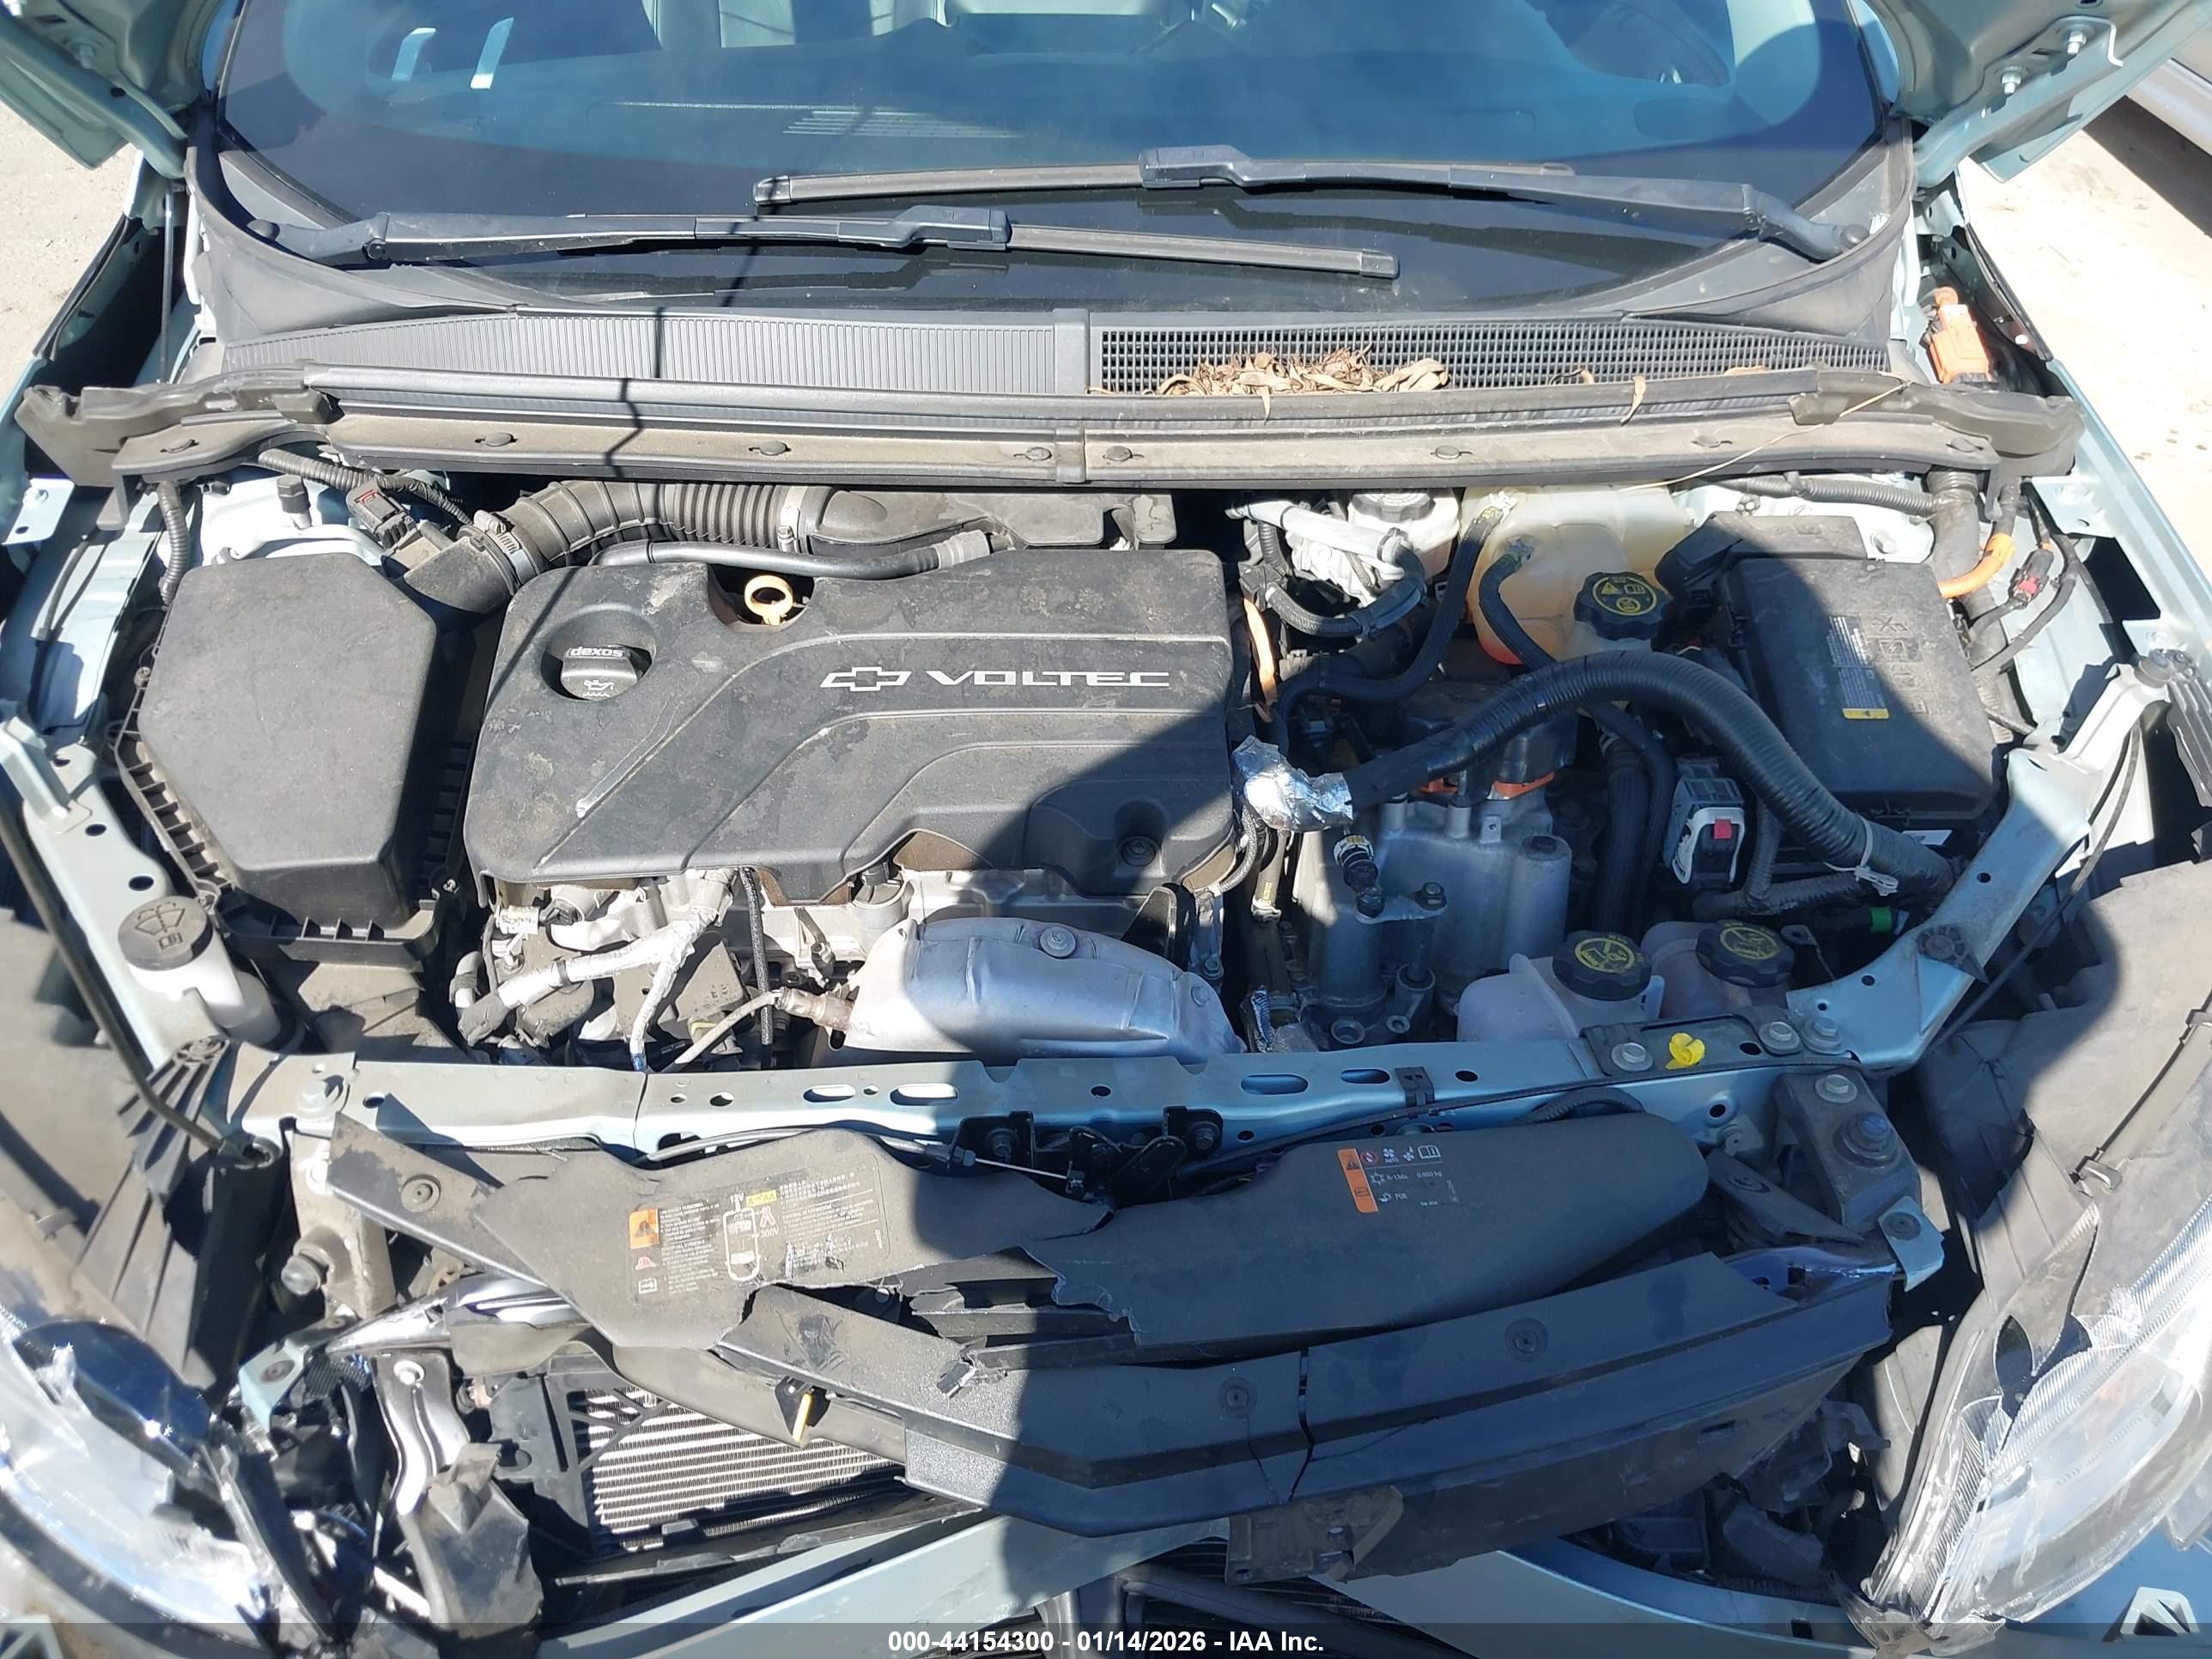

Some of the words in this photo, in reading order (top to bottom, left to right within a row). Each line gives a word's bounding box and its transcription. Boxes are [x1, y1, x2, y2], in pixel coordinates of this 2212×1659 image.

[570, 647, 623, 658] dexos
[926, 671, 1170, 687] VOLTEC
[730, 1192, 744, 1204] 12V
